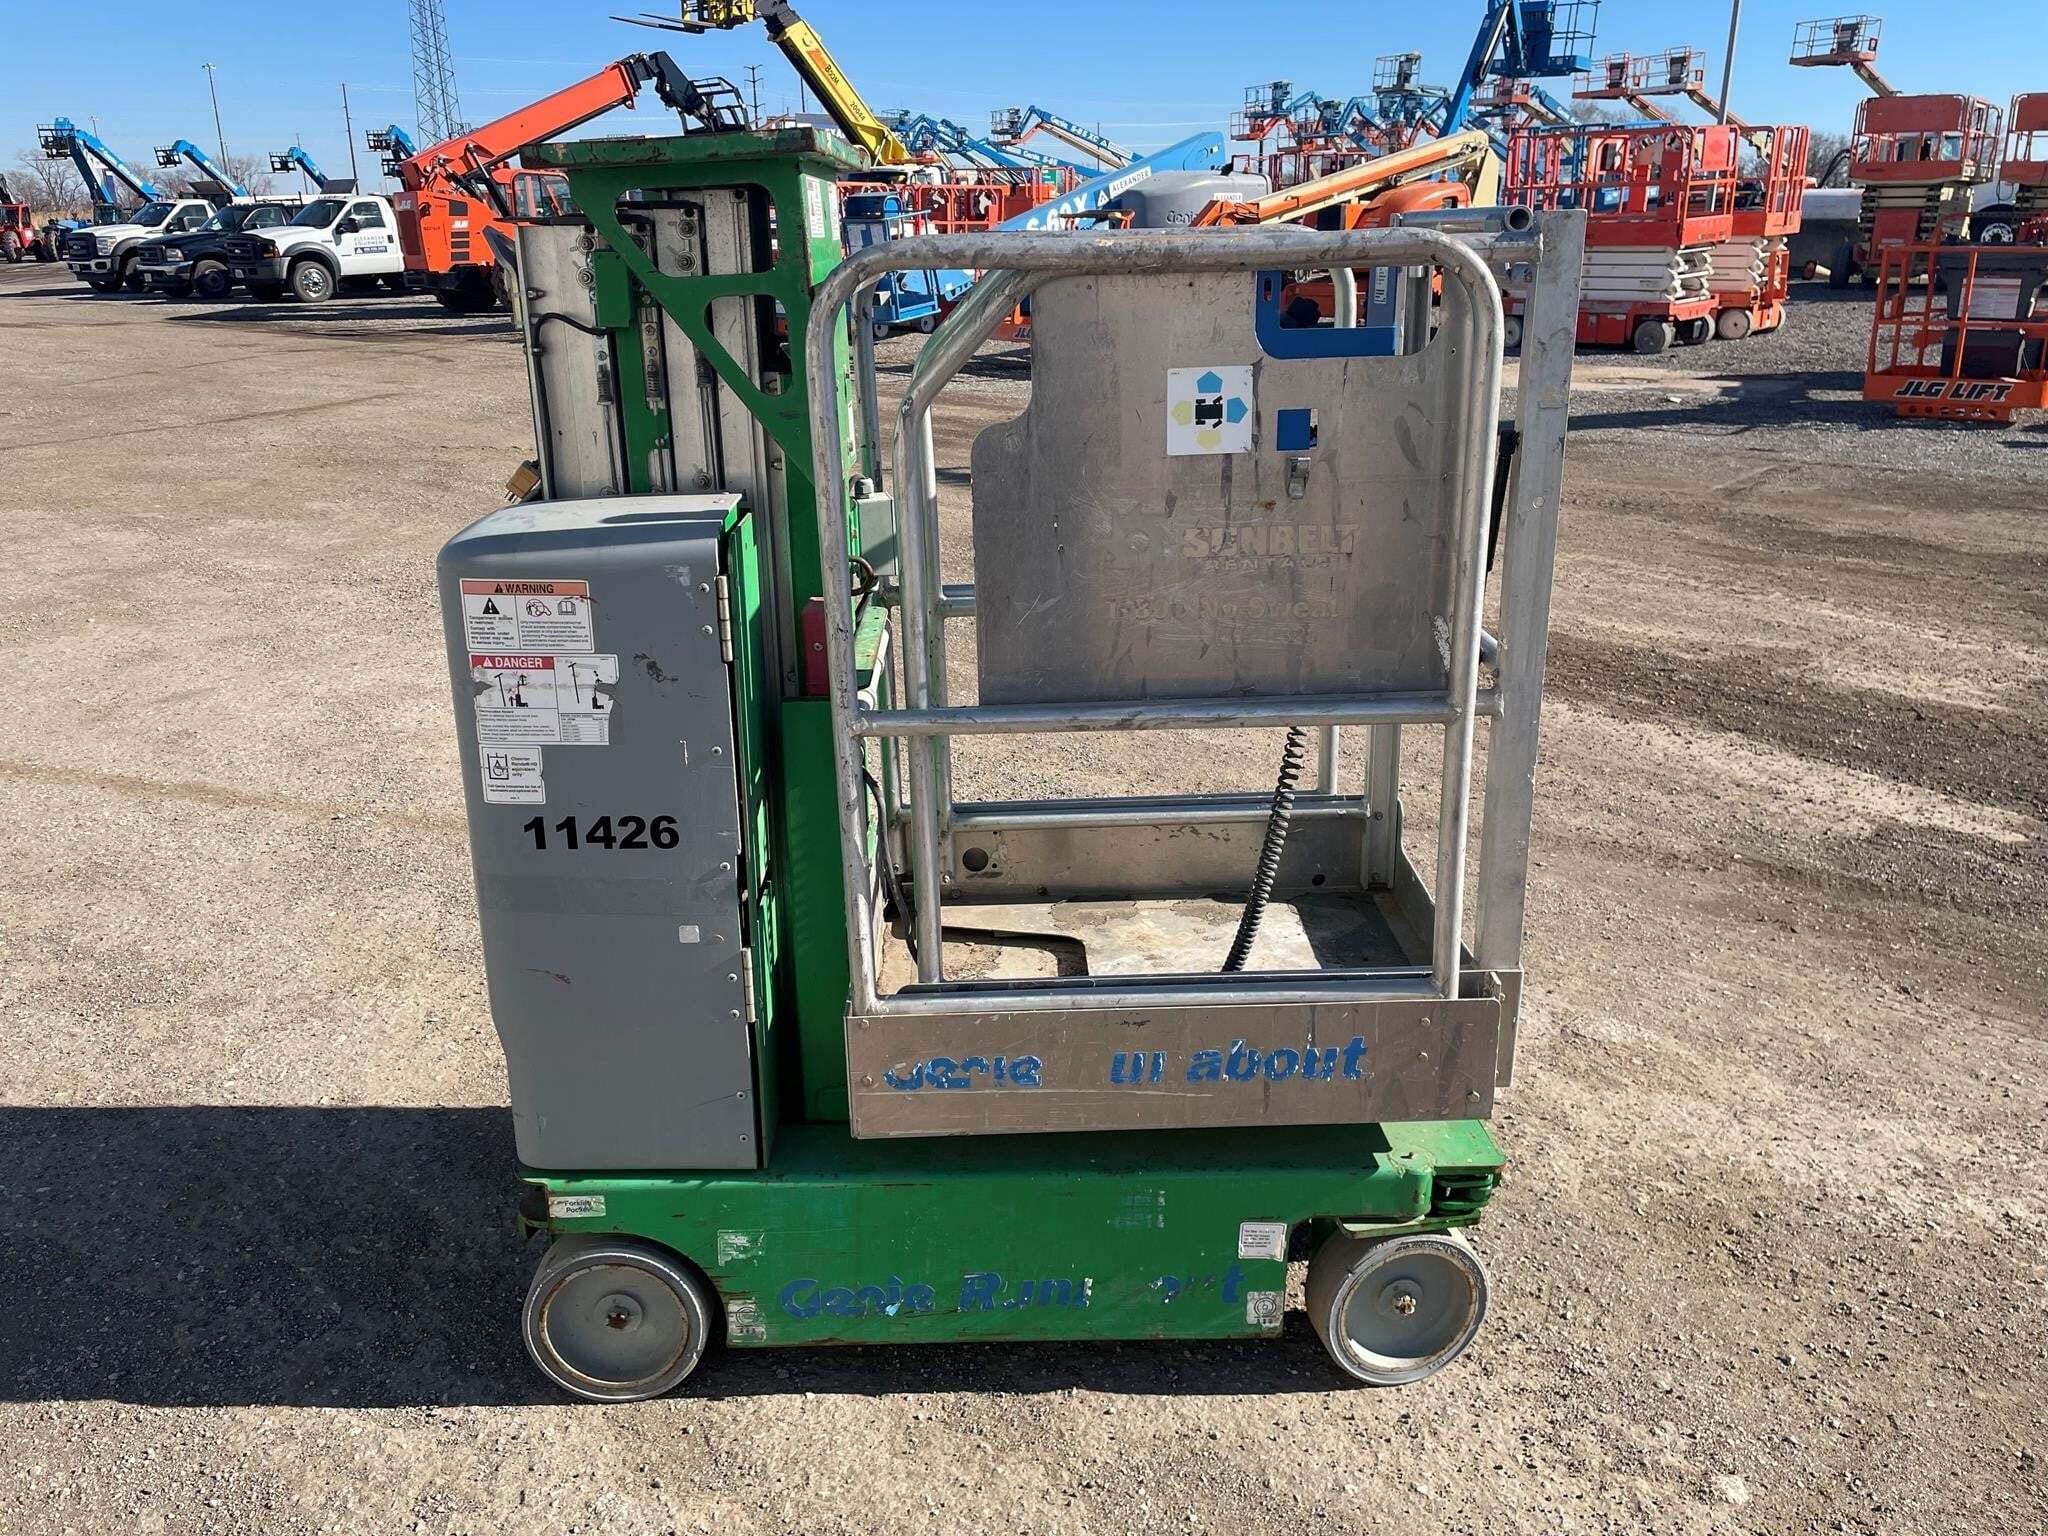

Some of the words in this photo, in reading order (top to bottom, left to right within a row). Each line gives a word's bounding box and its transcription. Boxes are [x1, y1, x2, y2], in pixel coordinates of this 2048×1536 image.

[1112, 169, 1149, 192] ALEXANDER
[1166, 208, 1194, 225] Geni
[1894, 379, 1948, 399] JLG
[1948, 381, 2014, 402] LIFT
[1183, 524, 1361, 558] SUNBELT
[505, 583, 554, 594] WARNING
[495, 657, 543, 669] DANGER
[523, 815, 680, 850] 11426
[780, 1273, 936, 1318] Genie
